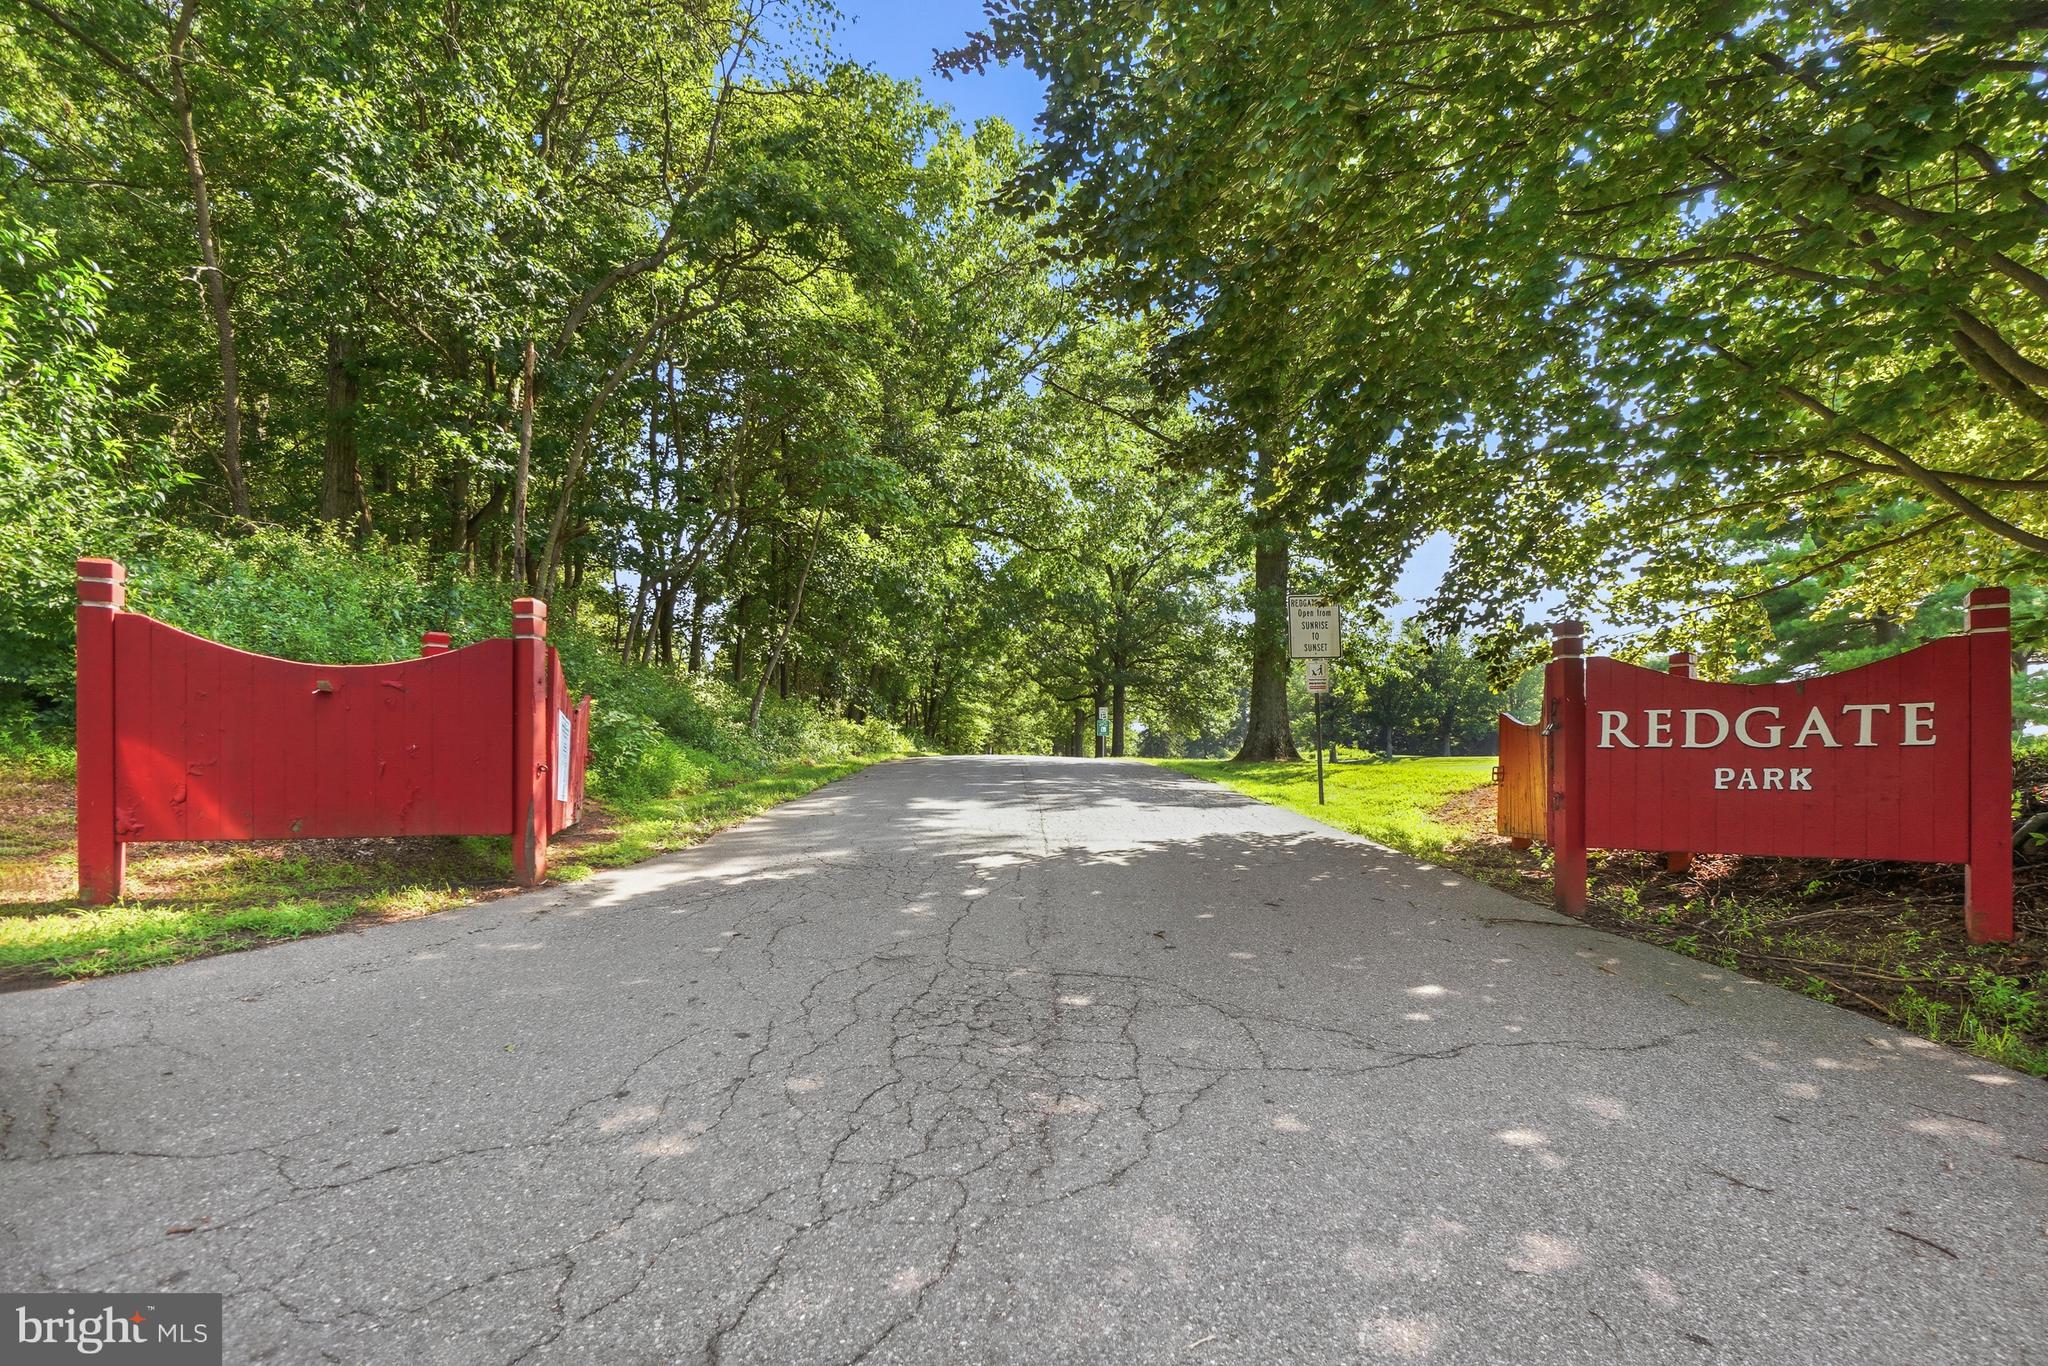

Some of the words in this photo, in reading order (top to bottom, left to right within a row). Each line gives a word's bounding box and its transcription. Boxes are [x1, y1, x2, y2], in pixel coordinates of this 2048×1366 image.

[1297, 609, 1314, 618] Open
[1317, 609, 1331, 617] from
[1301, 621, 1328, 630] SUNRISE
[1312, 632, 1320, 641] TO
[1303, 643, 1328, 652] SUNSET
[1596, 701, 1937, 749] REDGATE
[1714, 767, 1813, 791] PARK
